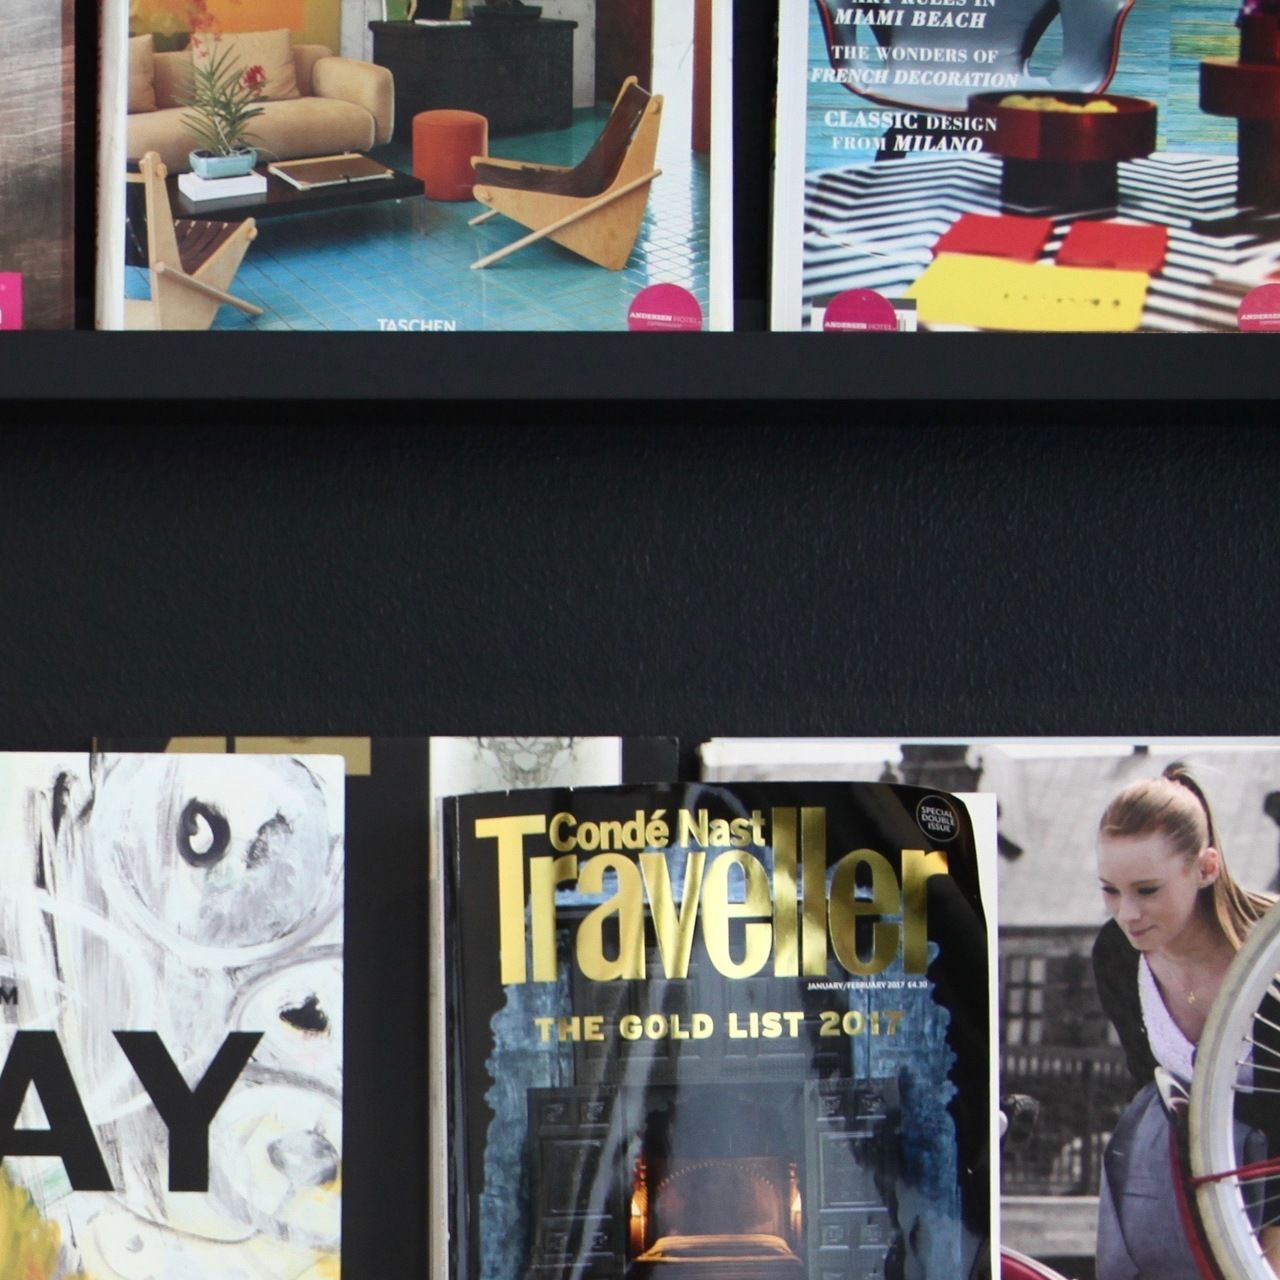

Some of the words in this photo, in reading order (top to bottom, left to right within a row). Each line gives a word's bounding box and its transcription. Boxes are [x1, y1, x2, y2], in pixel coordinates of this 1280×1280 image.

[834, 9, 905, 26] MIAMI
[911, 10, 987, 28] BEACH
[831, 45, 869, 60] THE
[876, 47, 968, 63] WONDERS
[973, 49, 999, 64] OF
[811, 68, 889, 84] FRENCH
[894, 69, 1019, 88] DECORATION
[824, 110, 918, 129] CLASSIC
[926, 115, 997, 132] DESIGN
[831, 135, 886, 150] FROM
[893, 135, 983, 153] MILANO
[920, 805, 954, 818] SPECIAL
[921, 813, 956, 827] DOUBLE
[547, 809, 670, 850] Condé
[678, 808, 765, 849] Nast
[927, 822, 951, 833] ISSUE
[474, 806, 949, 986] Traveller
[534, 1015, 606, 1043] THE
[620, 1013, 714, 1041] GOLD
[728, 1012, 805, 1039] LIST
[819, 1010, 907, 1038] 2017
